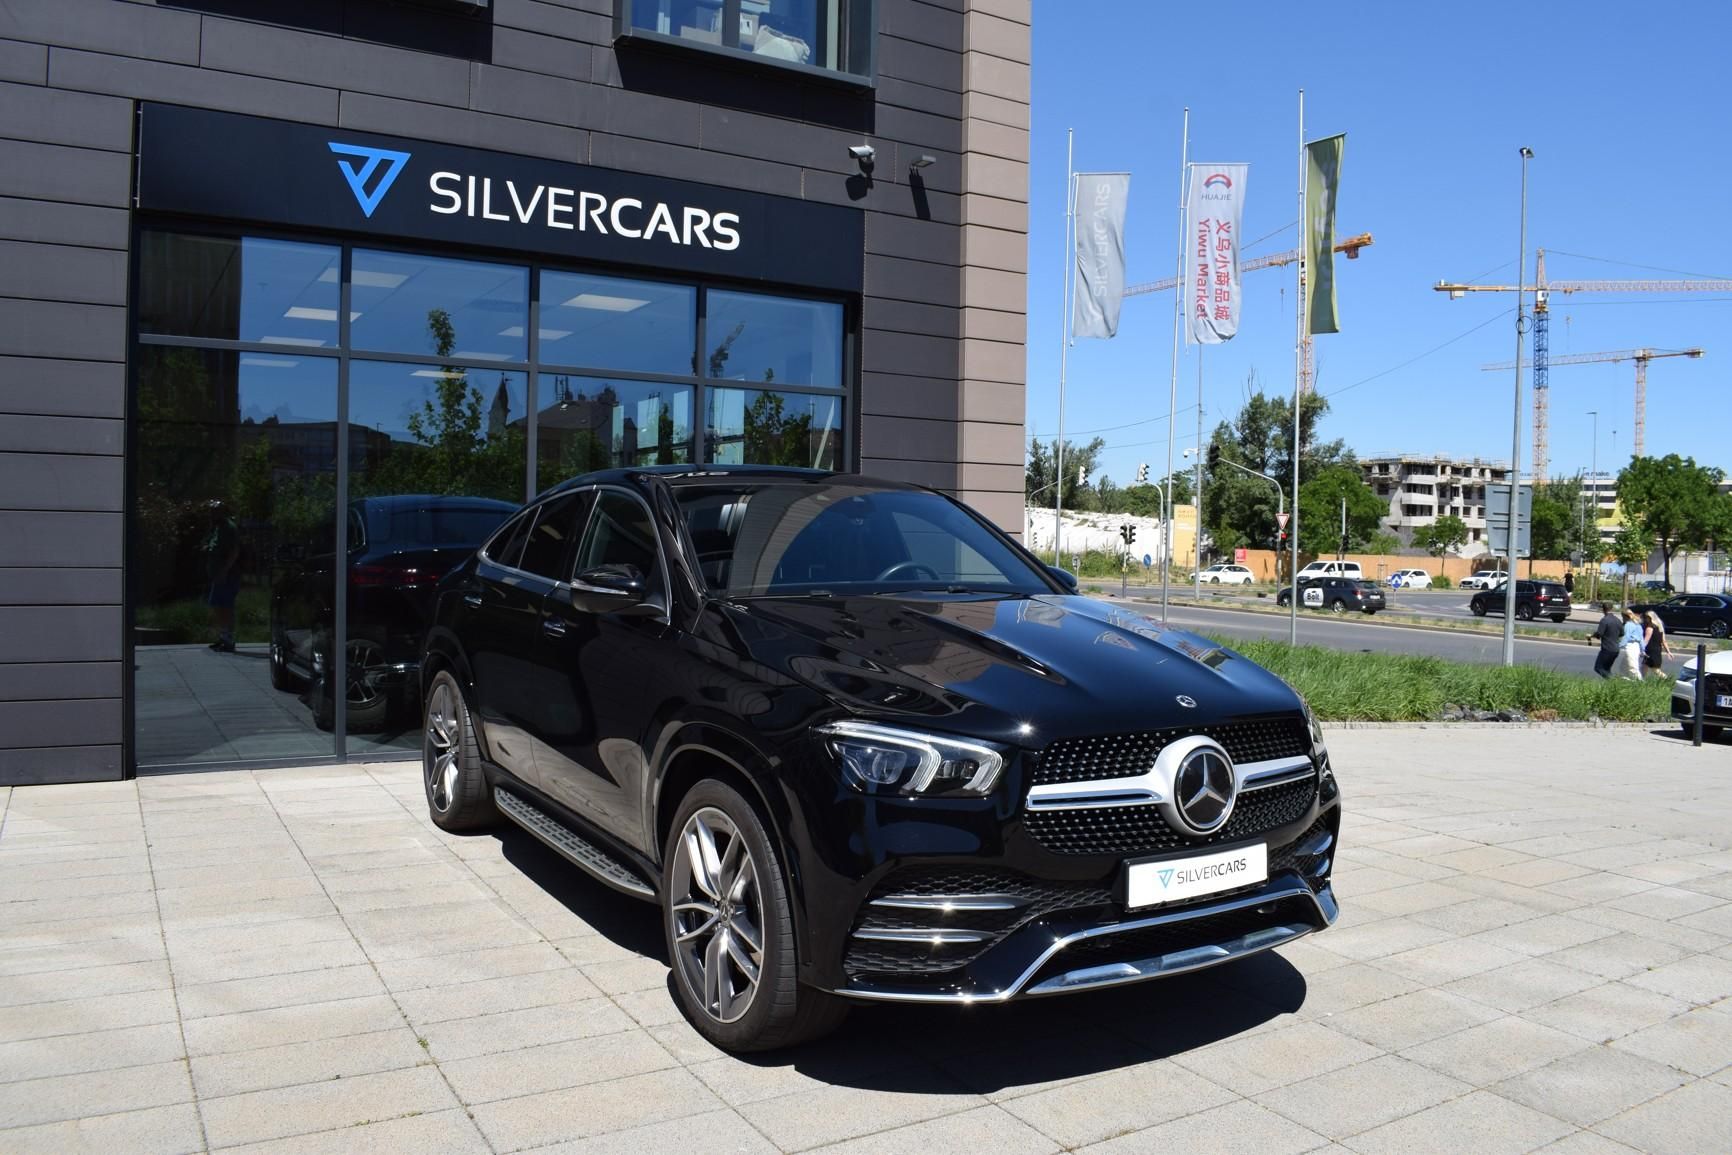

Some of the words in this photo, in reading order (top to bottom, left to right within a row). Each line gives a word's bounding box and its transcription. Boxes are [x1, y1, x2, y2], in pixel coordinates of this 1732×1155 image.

[430, 171, 741, 250] SILVERCARS
[1201, 193, 1232, 201] HUAJIE
[1094, 184, 1111, 297] SILVERCARS
[1198, 218, 1210, 258] Yiwu
[1197, 263, 1209, 319] Market
[1214, 219, 1232, 320] 义乌小商品城
[1177, 858, 1247, 884] SILVERCARS
